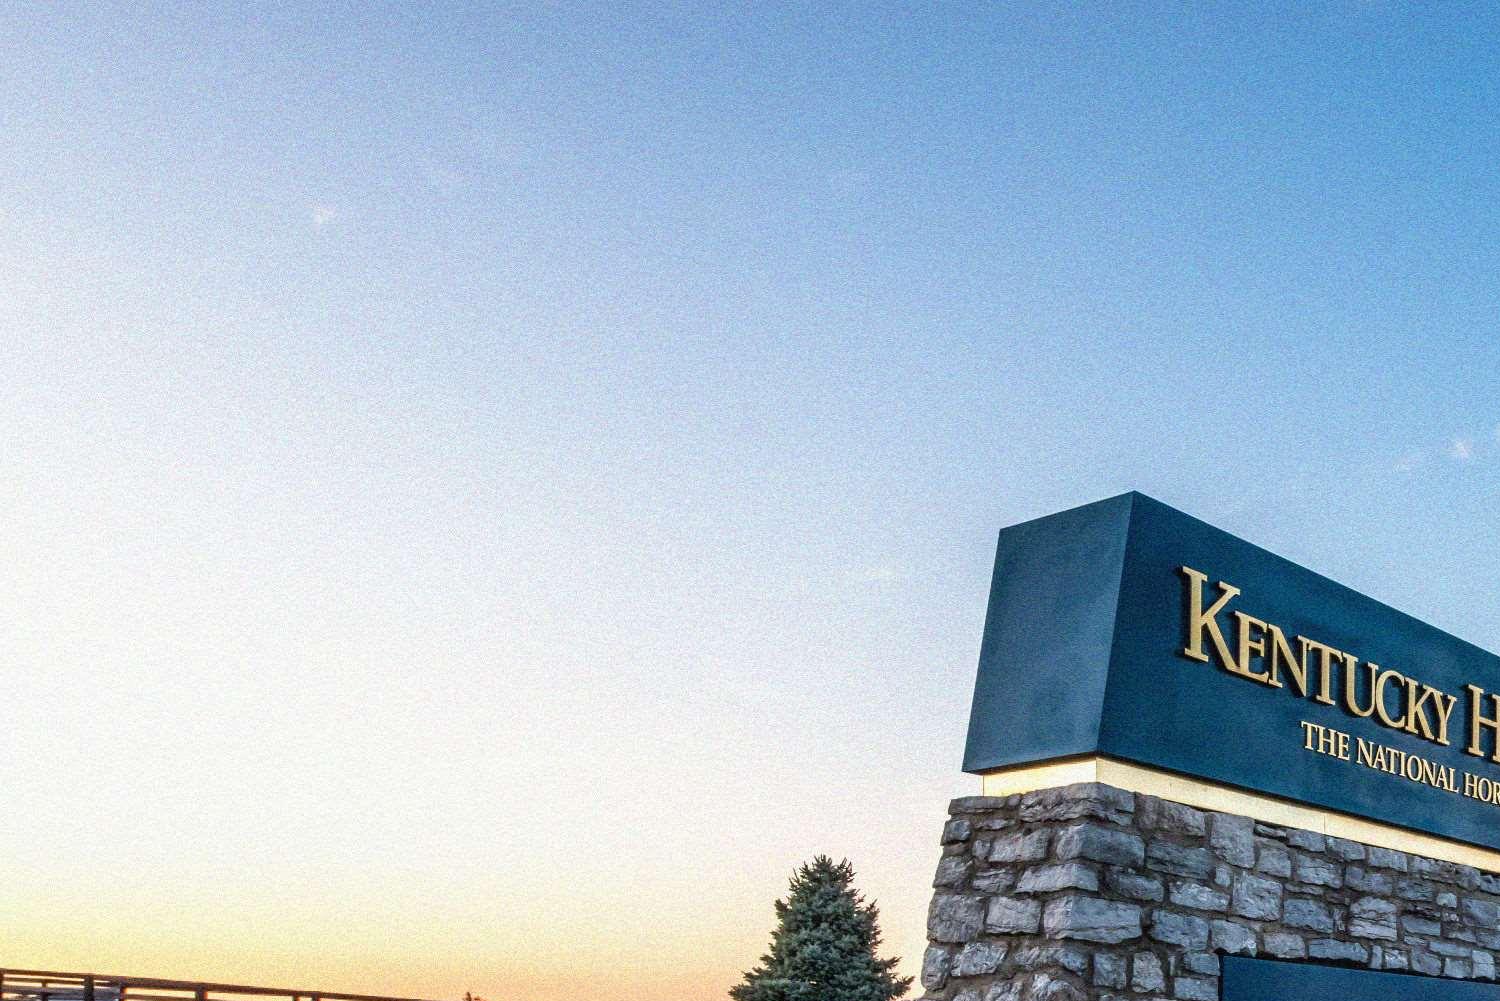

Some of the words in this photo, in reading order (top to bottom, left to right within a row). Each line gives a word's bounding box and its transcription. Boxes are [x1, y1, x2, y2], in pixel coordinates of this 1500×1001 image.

[1181, 565, 1456, 746] KENTUCKY
[1301, 721, 1350, 760] THE
[1356, 738, 1459, 794] NATIONAL
